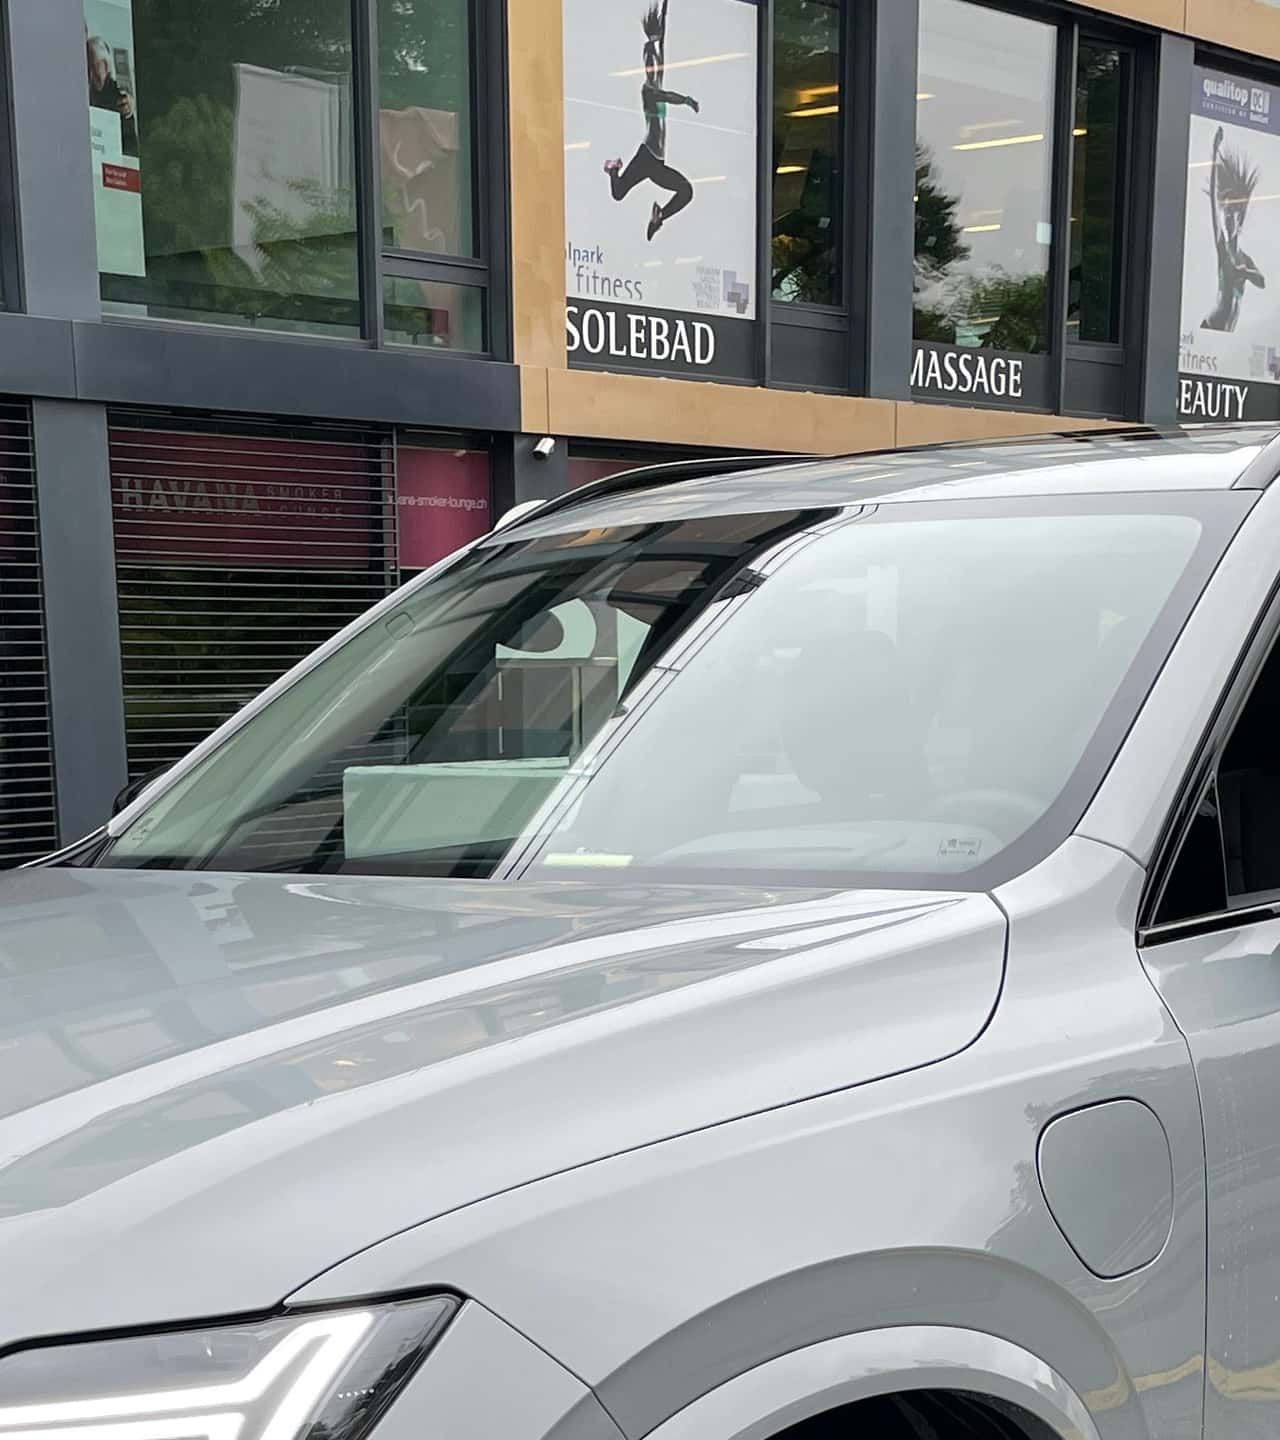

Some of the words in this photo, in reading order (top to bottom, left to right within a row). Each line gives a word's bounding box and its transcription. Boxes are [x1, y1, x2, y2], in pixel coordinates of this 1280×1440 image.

[1202, 79, 1249, 107] qualitop
[565, 240, 604, 268] lpark
[575, 264, 643, 301] fitness
[566, 306, 716, 365] SOLEBAD
[1180, 346, 1217, 371] itness
[1175, 378, 1249, 419] EAUTY
